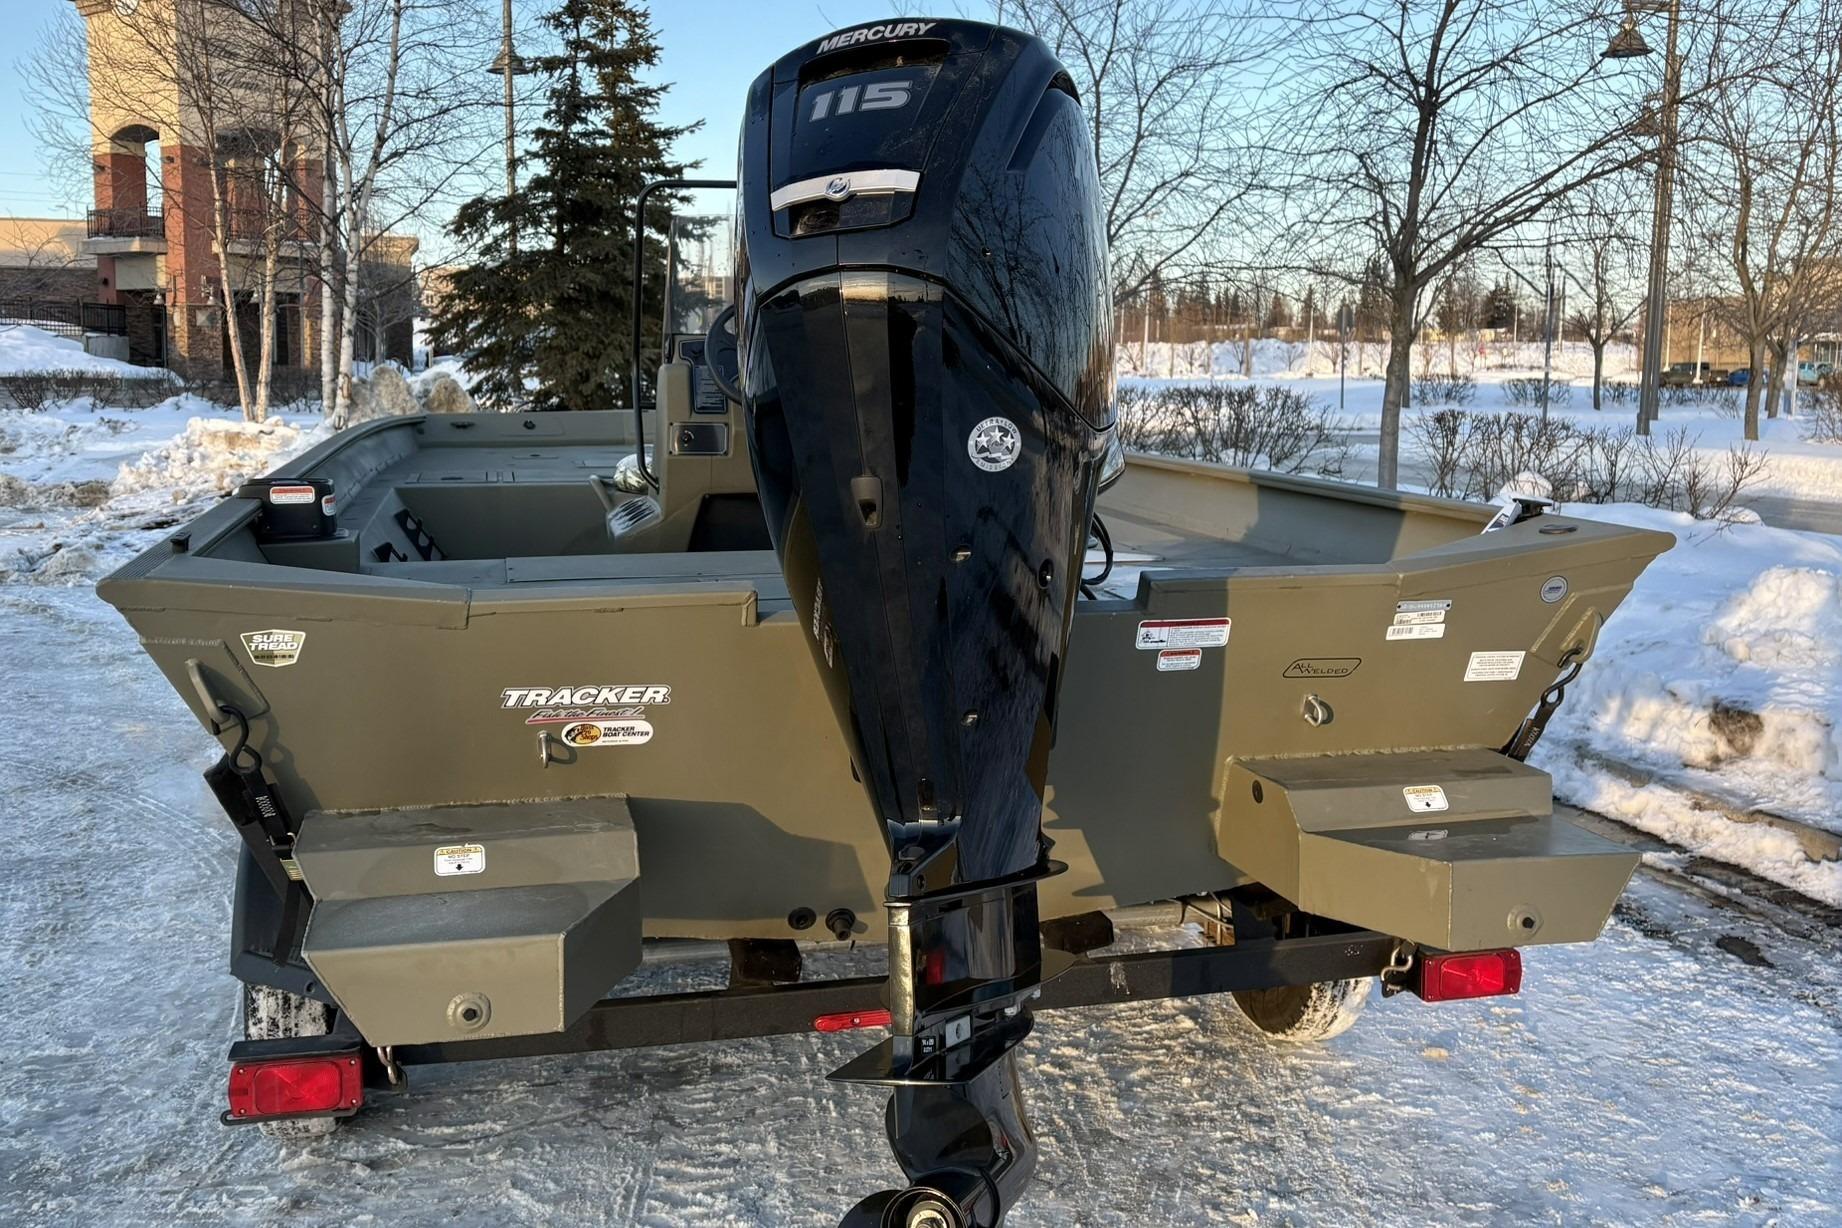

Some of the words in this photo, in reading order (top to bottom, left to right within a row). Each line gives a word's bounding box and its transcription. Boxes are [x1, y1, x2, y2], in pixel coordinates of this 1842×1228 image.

[816, 22, 936, 55] MERCURY
[809, 80, 913, 122] 115
[253, 634, 293, 643] SURE
[249, 642, 298, 651] TREAD
[1291, 663, 1314, 674] ALL
[1302, 667, 1349, 675] WELDED
[502, 685, 670, 708] TRACKER
[530, 708, 561, 719] Fish
[561, 708, 586, 719] the
